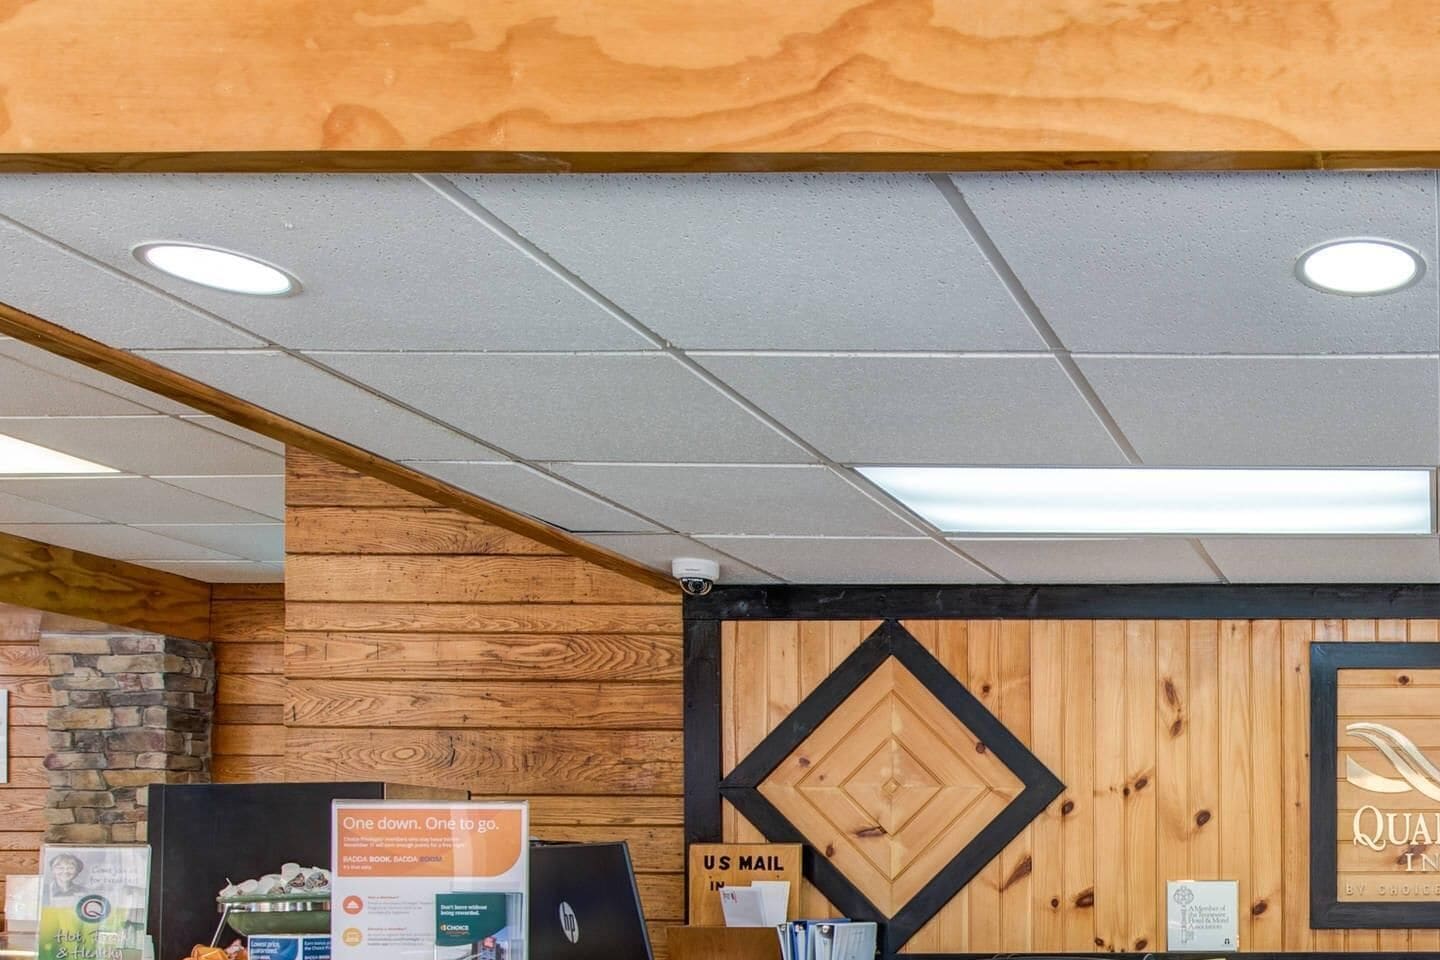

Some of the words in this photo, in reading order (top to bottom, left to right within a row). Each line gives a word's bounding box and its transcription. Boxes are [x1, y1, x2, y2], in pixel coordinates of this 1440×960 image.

[343, 817, 374, 830] One
[377, 817, 422, 830] down.
[425, 817, 456, 830] One
[459, 818, 474, 830] to
[477, 820, 500, 833] go.
[738, 855, 784, 871] MAIL
[710, 881, 725, 891] IN
[1345, 884, 1366, 895] BY
